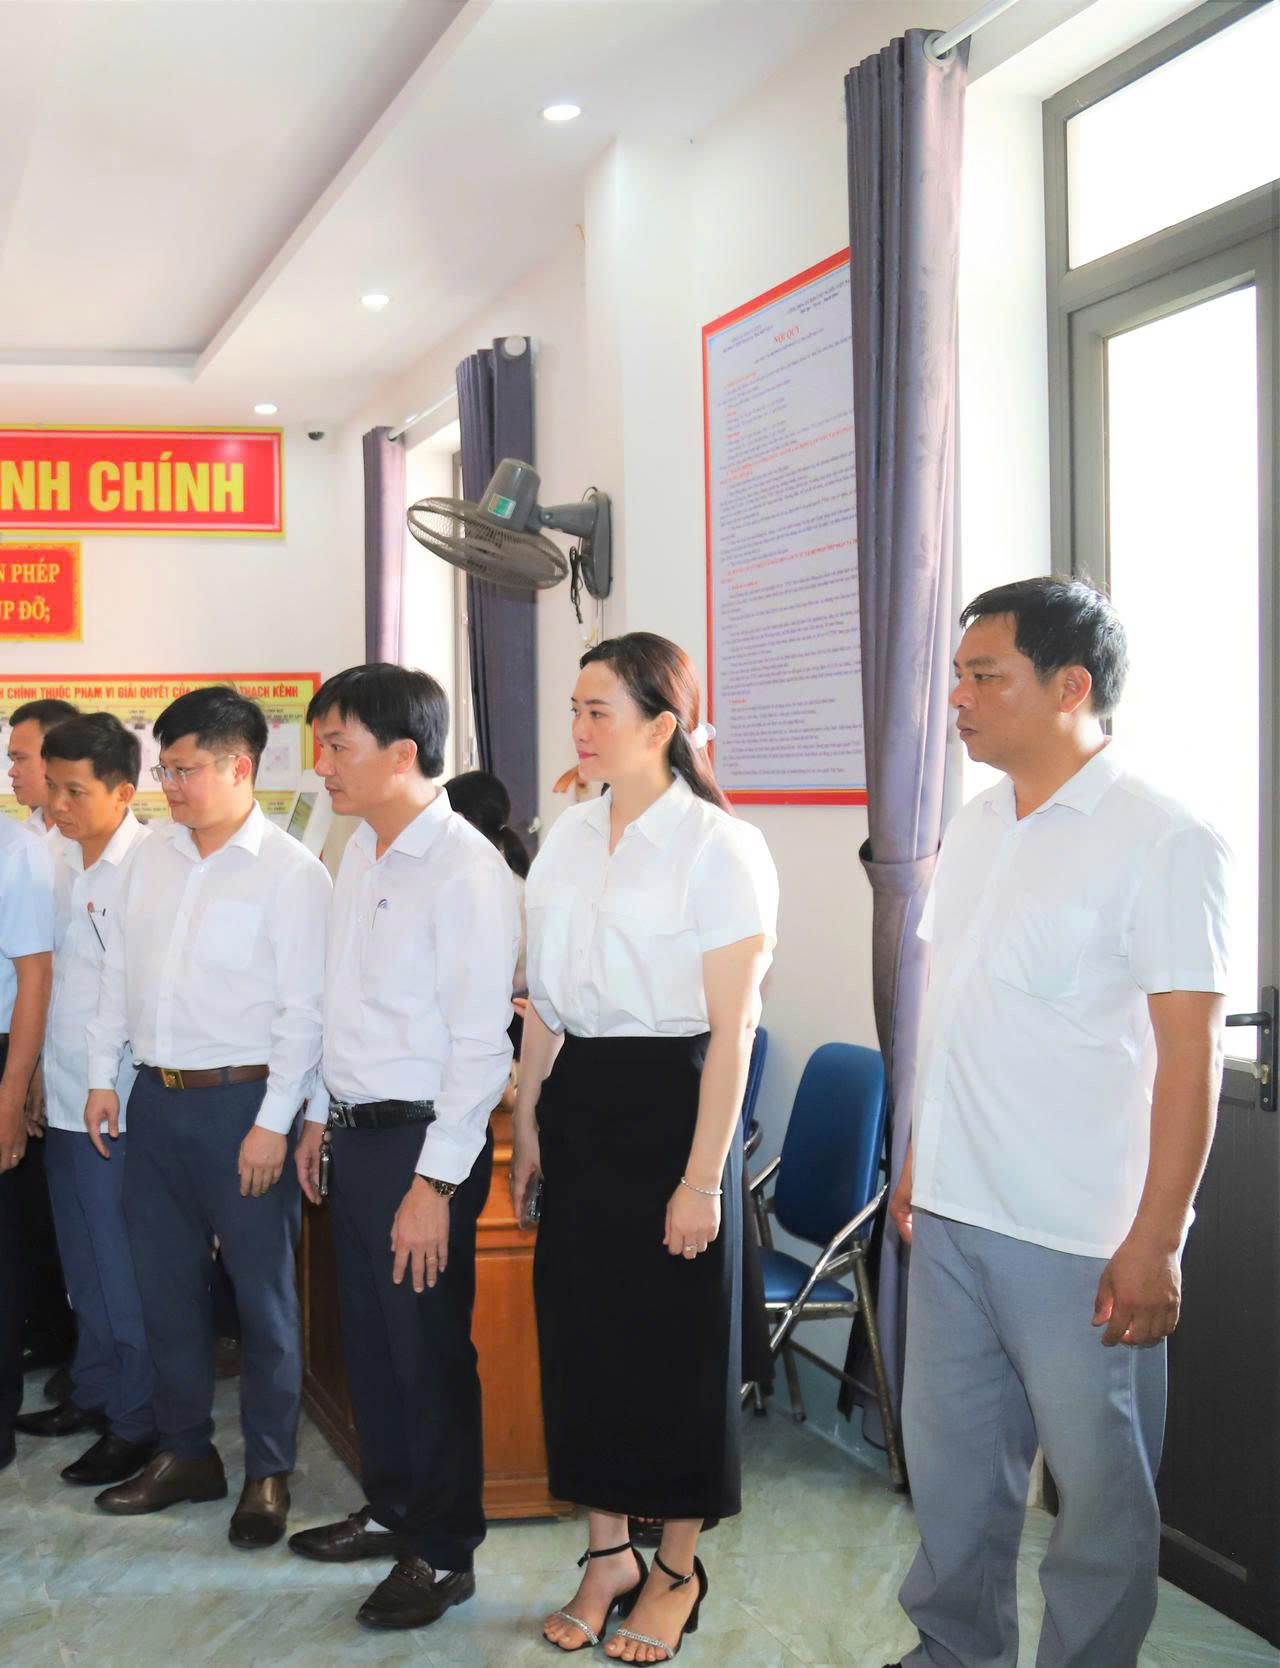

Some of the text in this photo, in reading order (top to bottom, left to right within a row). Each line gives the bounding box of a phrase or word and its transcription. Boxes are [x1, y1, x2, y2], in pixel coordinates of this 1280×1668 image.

[89, 452, 244, 513] CHÍNH
[10, 557, 61, 584] PHÉP
[19, 595, 51, 624] ĐỠ;
[105, 687, 115, 699] VI
